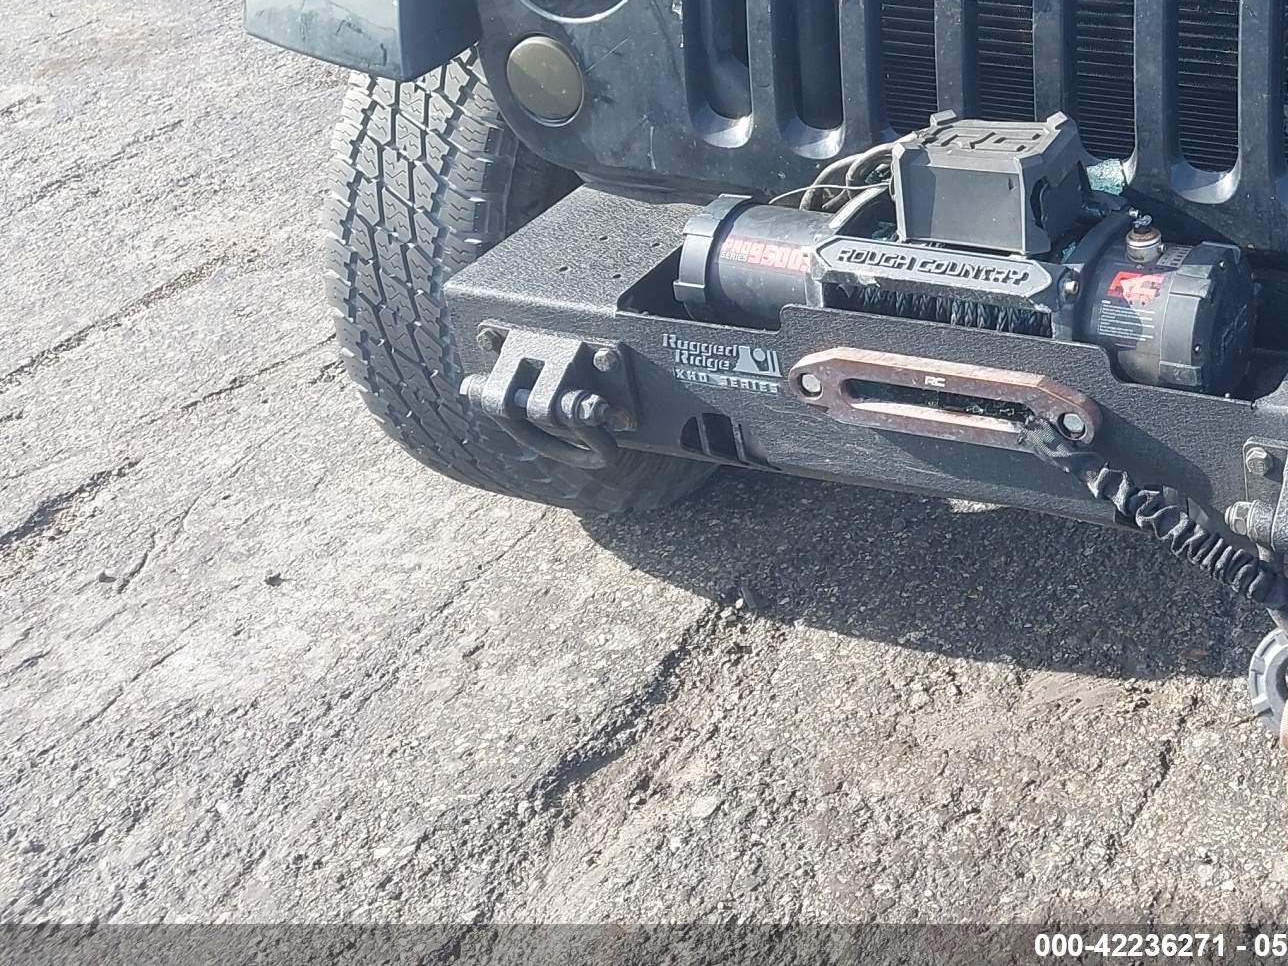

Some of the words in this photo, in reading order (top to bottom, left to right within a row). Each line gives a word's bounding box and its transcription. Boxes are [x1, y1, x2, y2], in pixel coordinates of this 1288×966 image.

[720, 251, 748, 262] SERIES
[836, 248, 915, 271] ROUGH
[919, 259, 1030, 286] COUNTRY
[662, 334, 738, 356] Rugged
[675, 349, 730, 371] Ridge
[718, 375, 779, 393] SERIES
